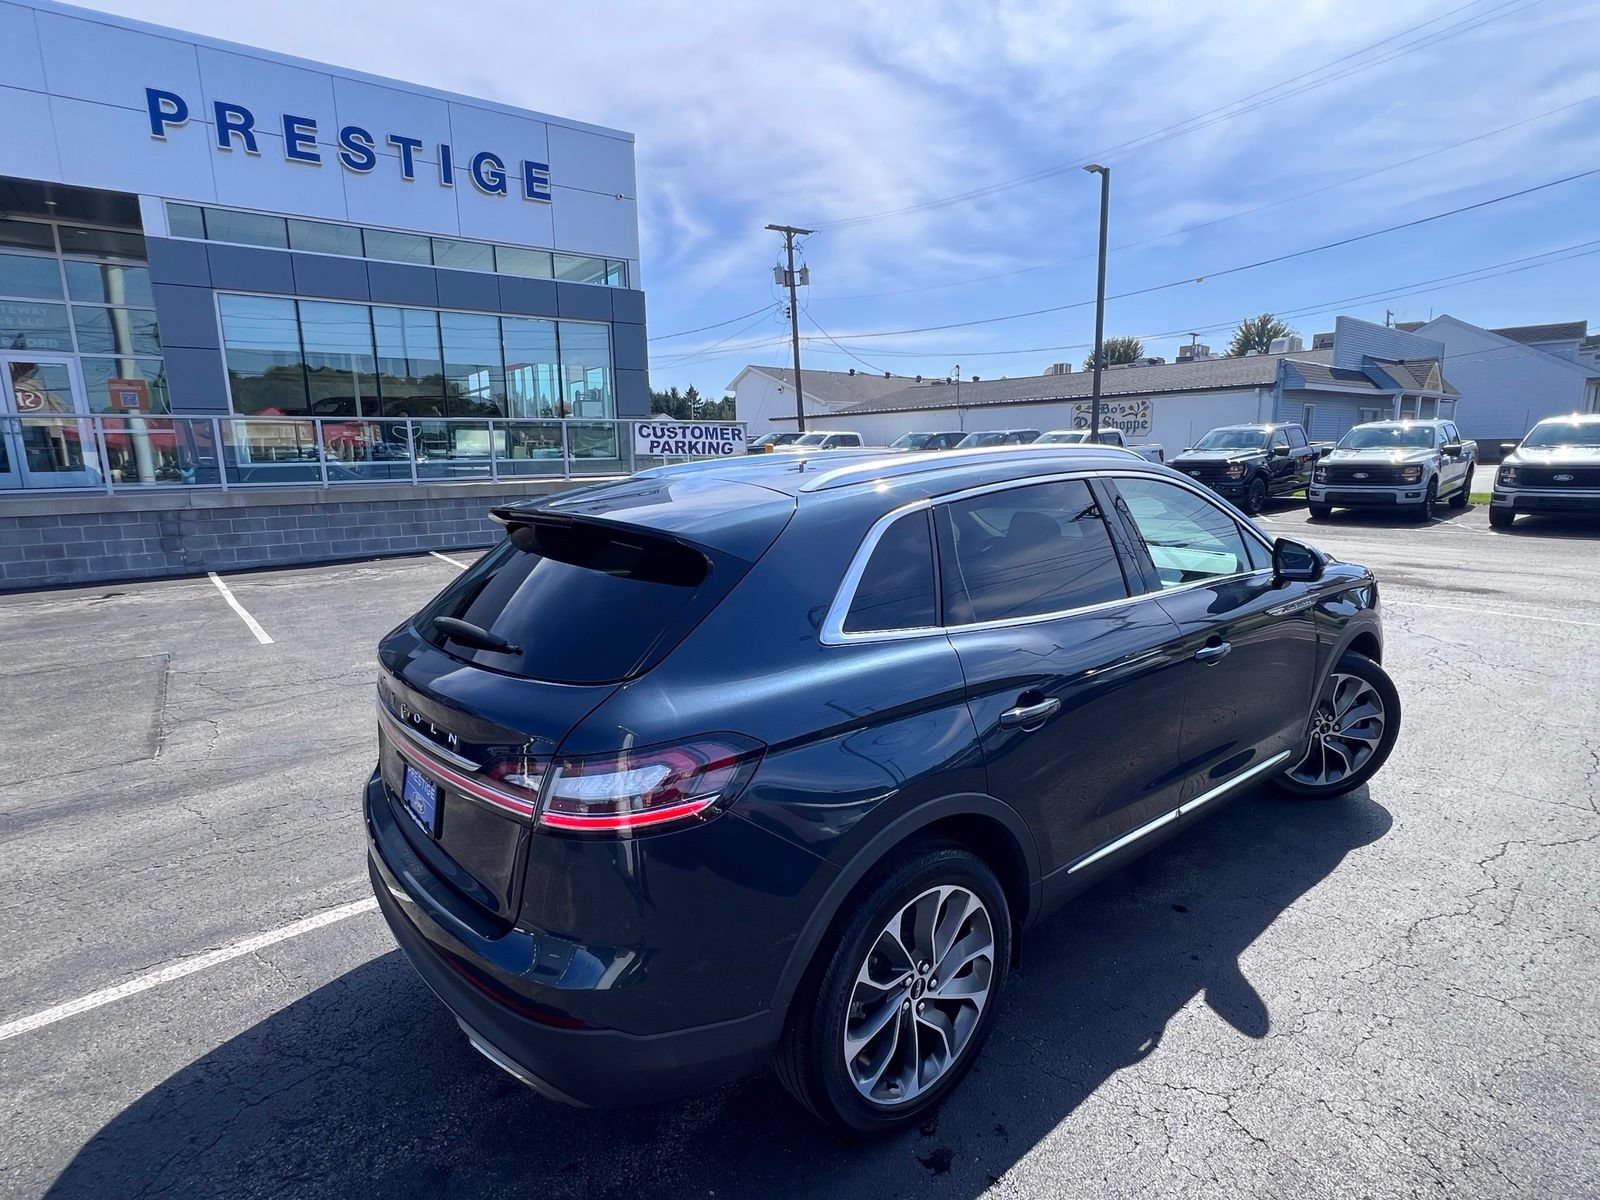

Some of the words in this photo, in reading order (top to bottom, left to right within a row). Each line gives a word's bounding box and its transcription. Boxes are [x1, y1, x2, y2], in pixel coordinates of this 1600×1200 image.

[145, 87, 552, 202] PRESTIGE
[0, 305, 48, 316] TEWAY
[638, 424, 744, 441] CUSTOMER
[1103, 415, 1149, 434] Shoppe
[649, 440, 734, 455] PARKING
